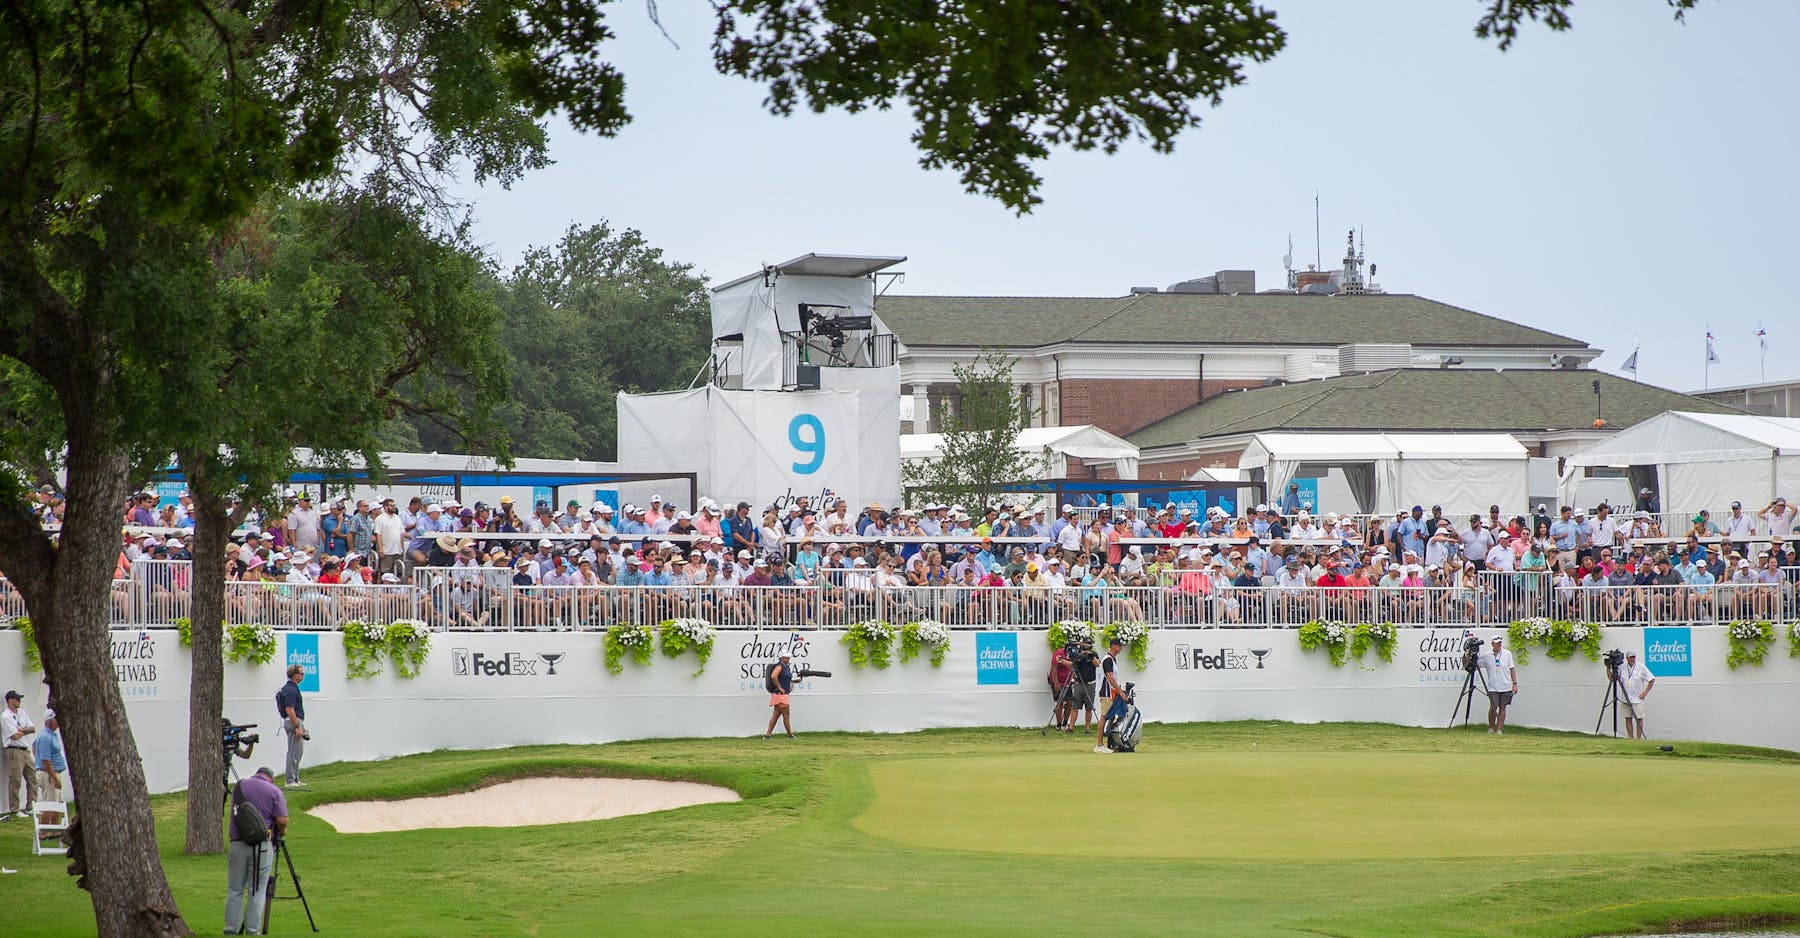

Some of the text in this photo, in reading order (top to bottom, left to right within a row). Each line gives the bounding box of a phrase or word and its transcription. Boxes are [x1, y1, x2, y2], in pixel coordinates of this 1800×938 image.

[788, 413, 825, 475] 9
[109, 632, 155, 659] harles
[1420, 629, 1466, 653] charl
[1648, 640, 1687, 653] charles
[289, 649, 316, 664] charles
[980, 646, 1014, 660] charles
[1193, 648, 1248, 670] FedEx
[1648, 653, 1688, 662] SCHWAB
[116, 664, 156, 682] HWAB
[473, 652, 537, 676] FedEx
[980, 660, 1015, 670] SCHWAB
